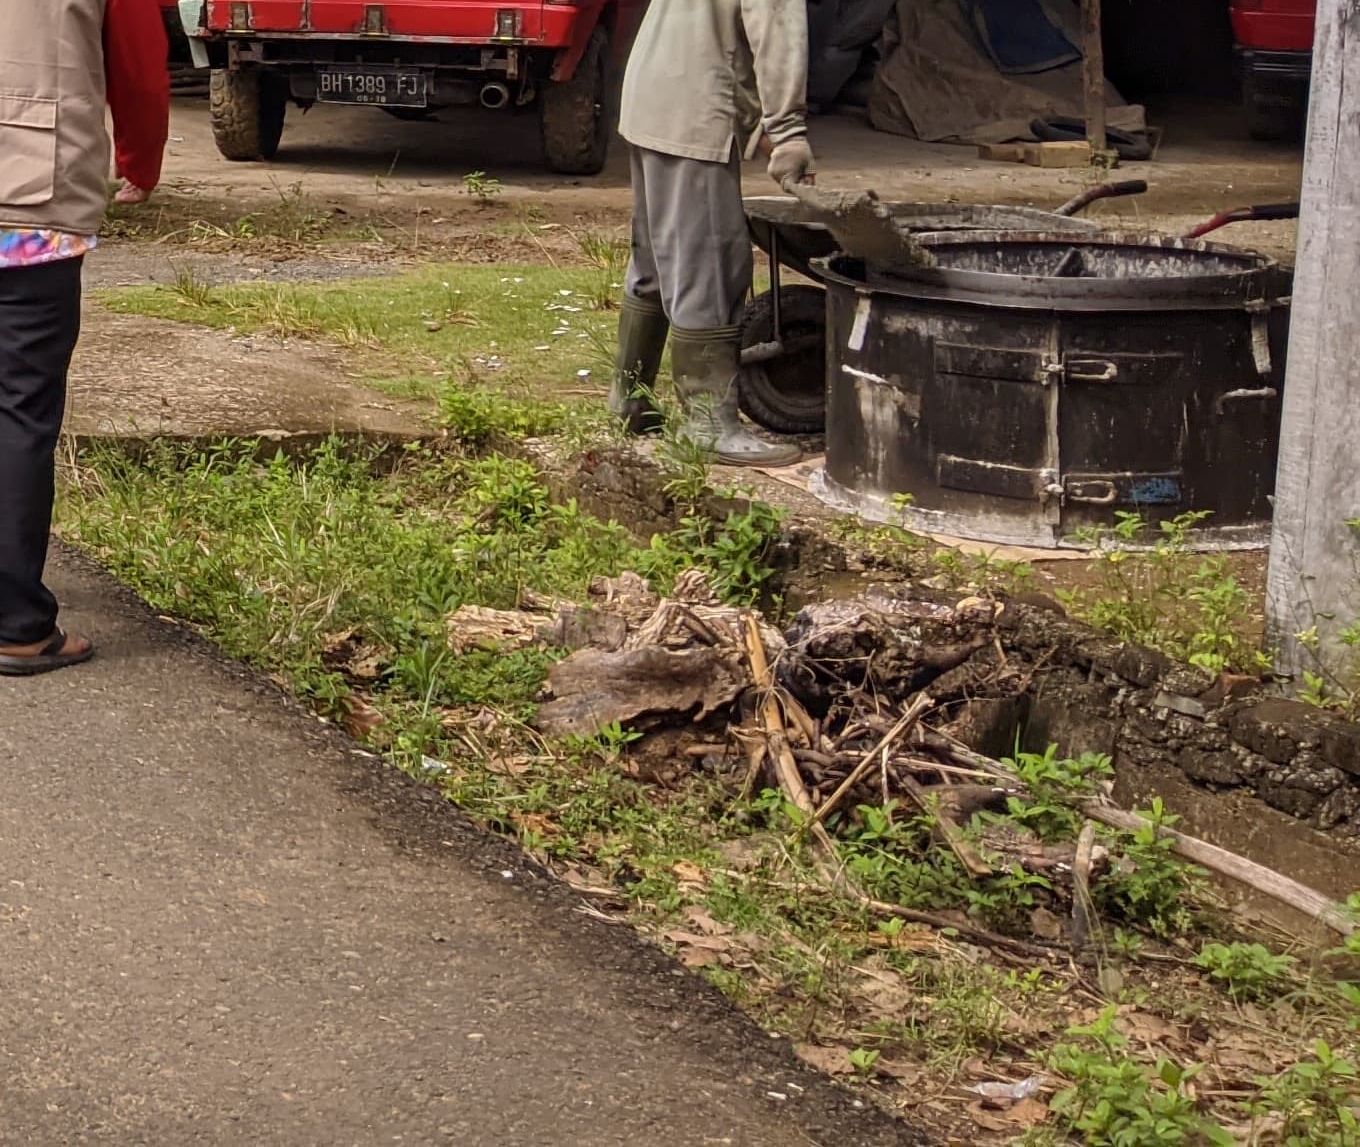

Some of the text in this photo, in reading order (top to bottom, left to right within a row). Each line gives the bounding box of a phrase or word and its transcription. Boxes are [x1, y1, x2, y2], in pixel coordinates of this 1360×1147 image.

[321, 73, 418, 95] BH 1389 FJ
